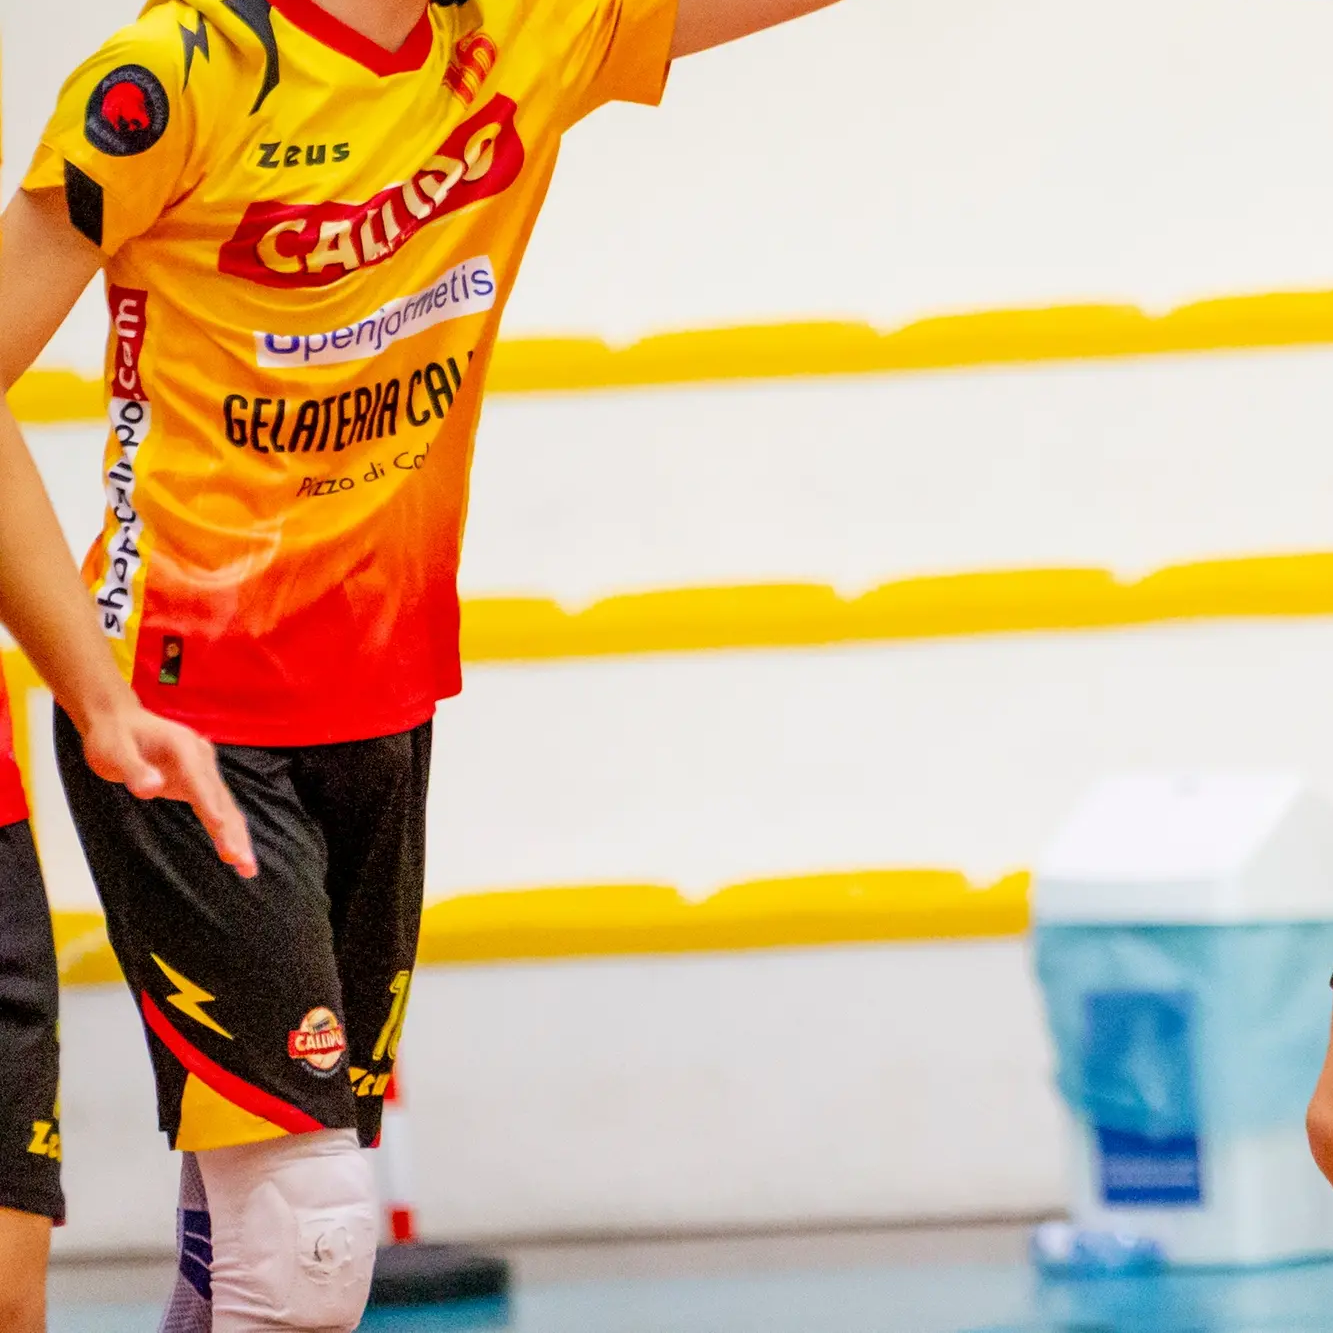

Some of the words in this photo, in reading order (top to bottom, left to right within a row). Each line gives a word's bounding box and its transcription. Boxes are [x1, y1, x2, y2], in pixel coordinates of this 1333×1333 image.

[256, 141, 351, 169] Zeus
[222, 377, 400, 454] GELATERIA
[295, 476, 355, 498] Pizzo
[363, 462, 386, 483] di
